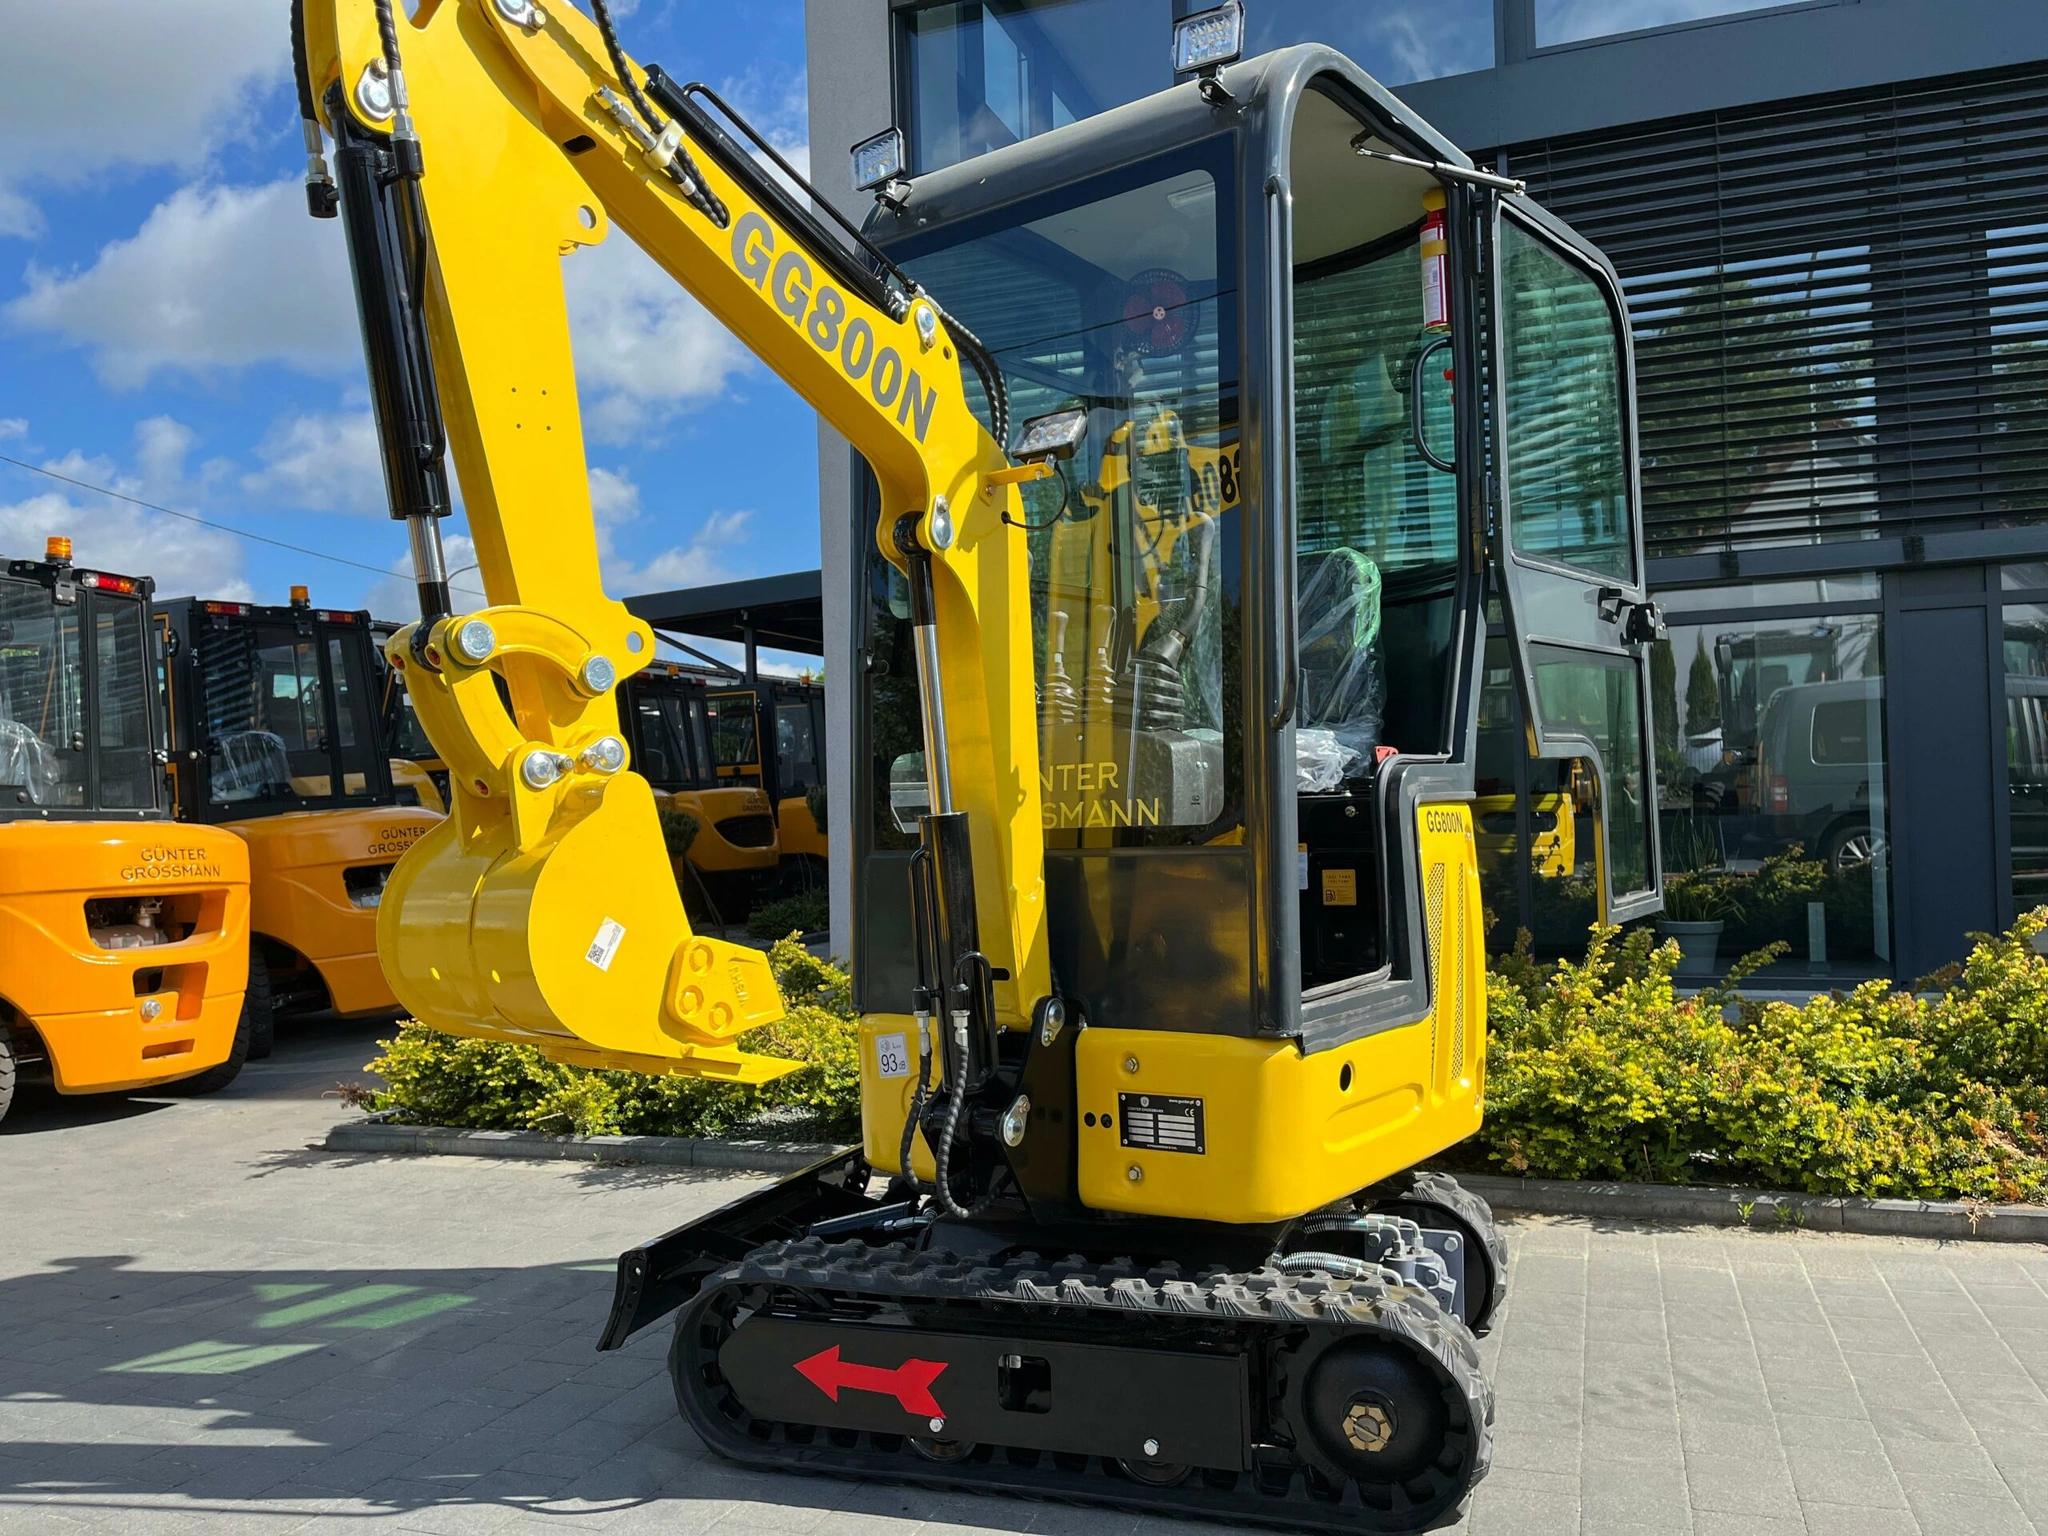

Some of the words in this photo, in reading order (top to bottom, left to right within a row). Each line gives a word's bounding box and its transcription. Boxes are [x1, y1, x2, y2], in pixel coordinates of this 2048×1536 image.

[730, 212, 937, 444] GG800N
[1426, 810, 1464, 833] GG800N
[381, 826, 426, 840] GÜNTER
[141, 844, 206, 862] GÜNTER
[367, 840, 414, 855] GROSS
[120, 864, 221, 881] GROSSMANN
[881, 1053, 898, 1073] 93
